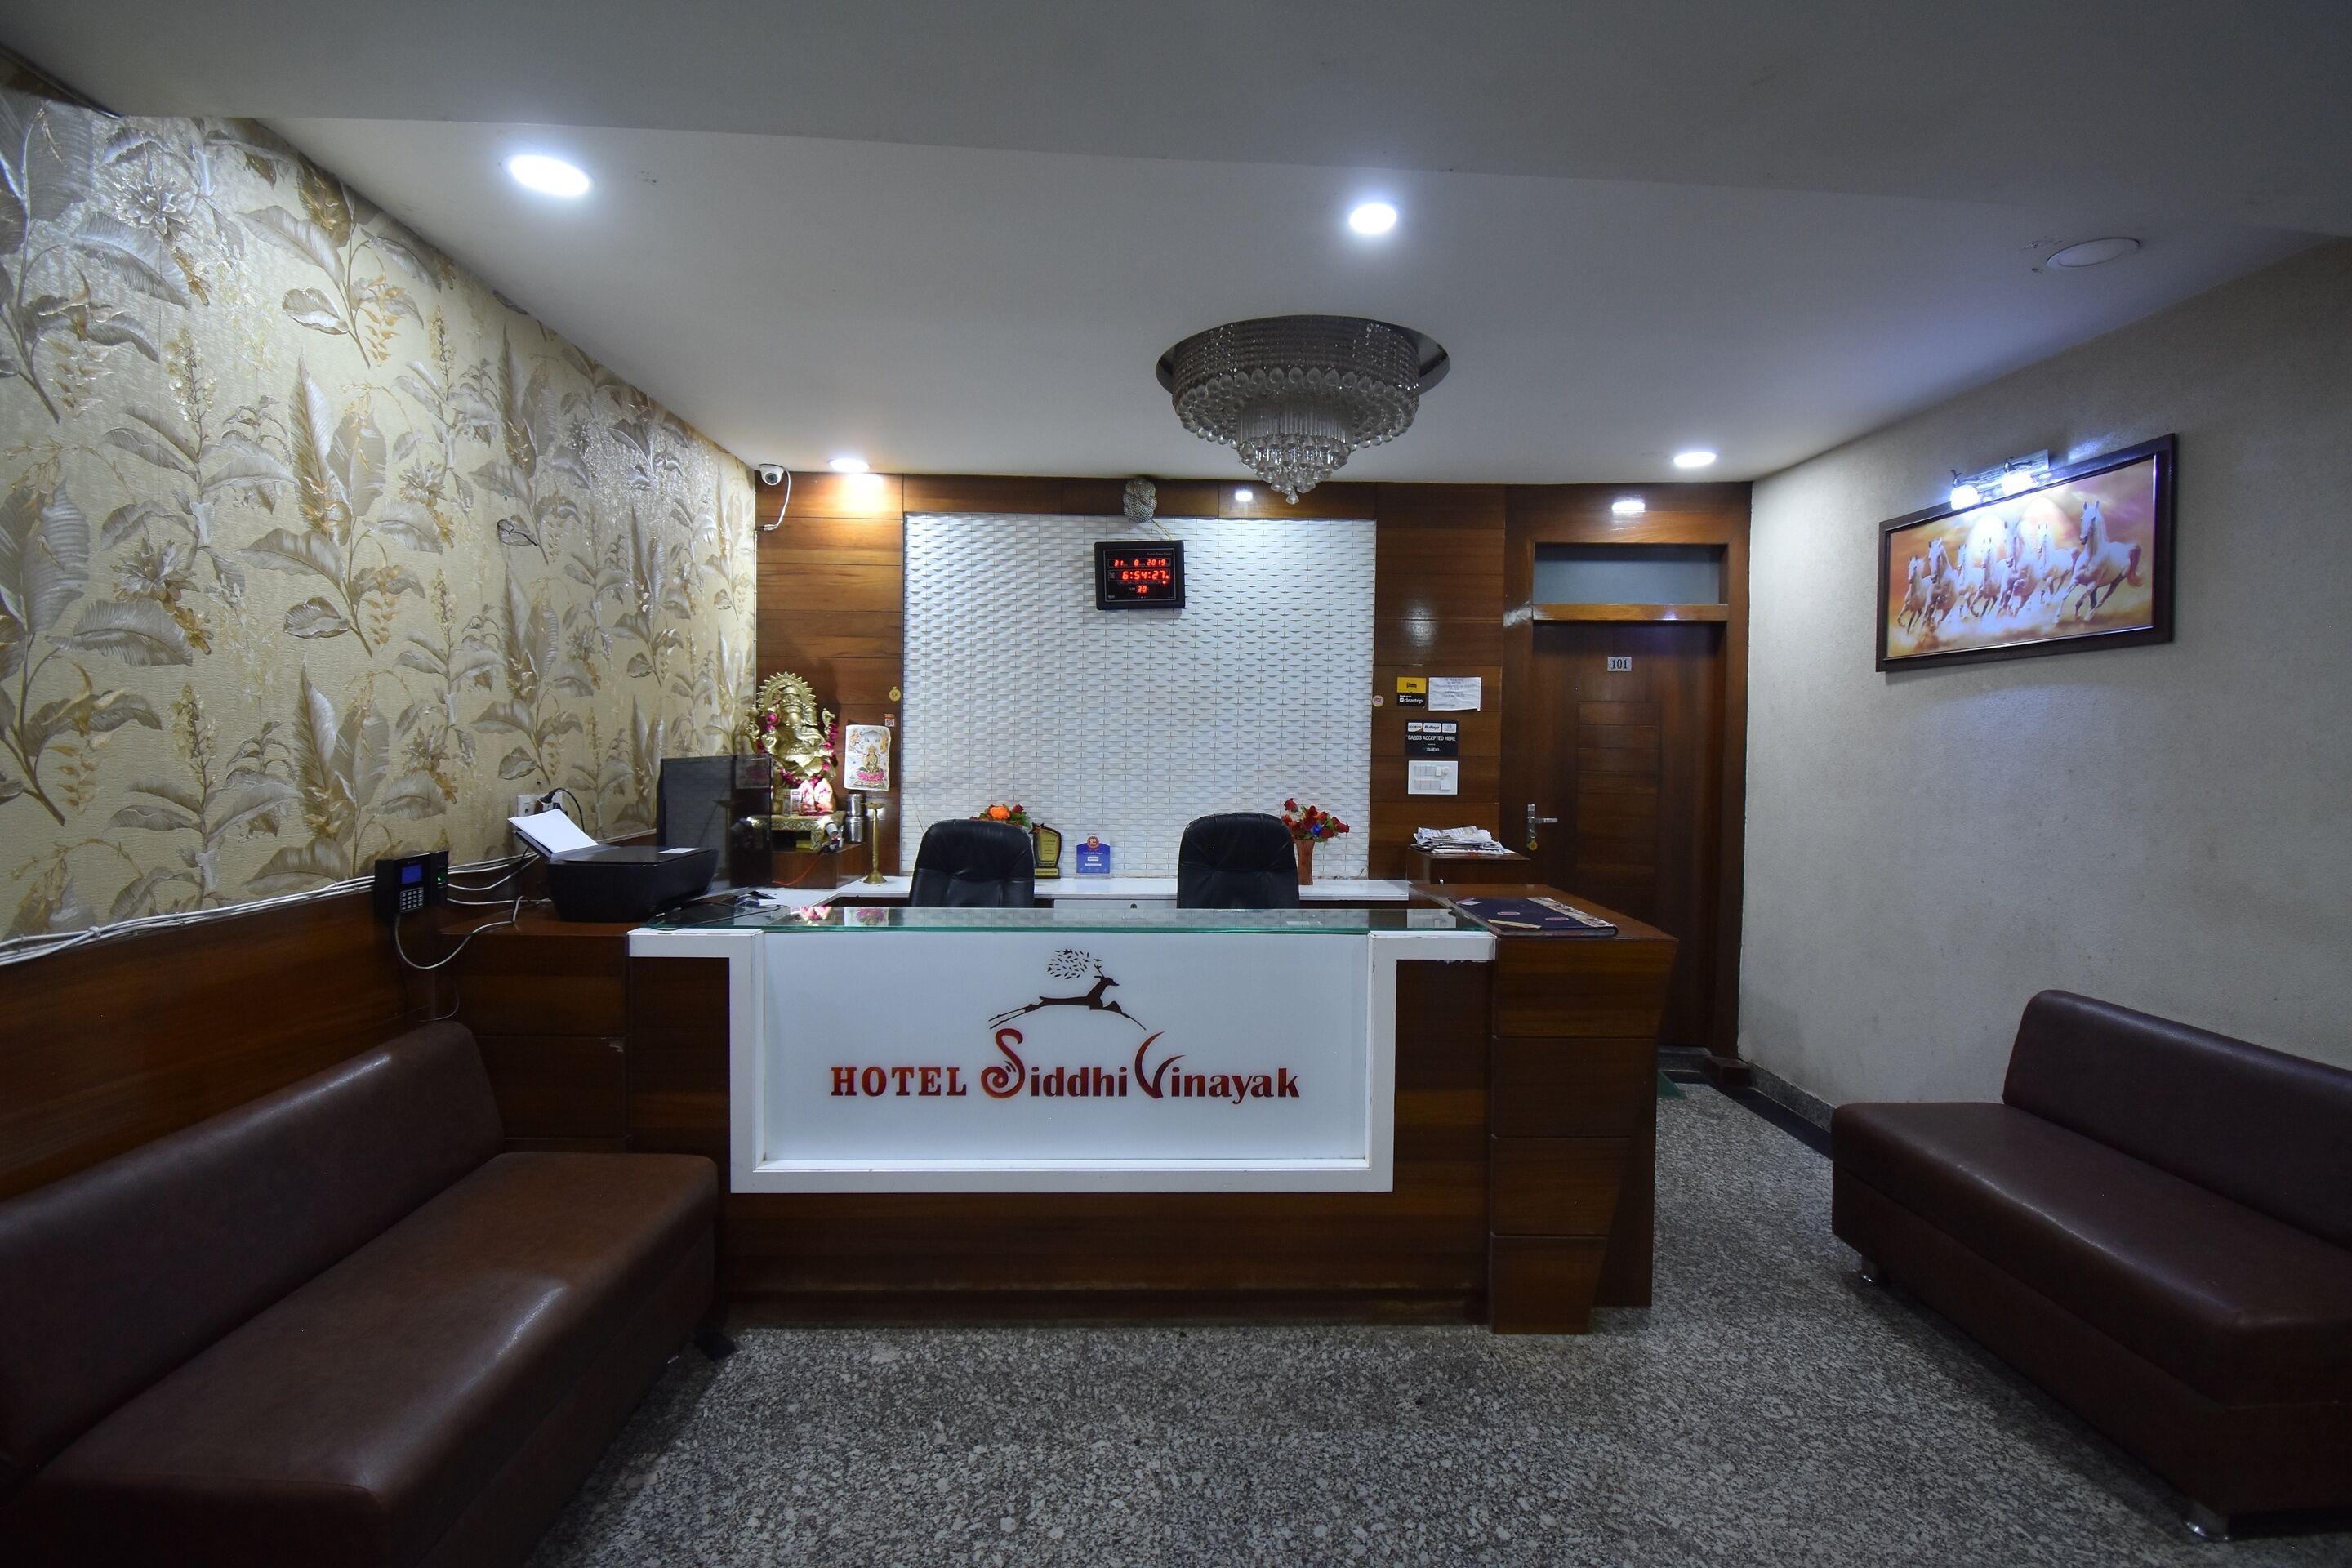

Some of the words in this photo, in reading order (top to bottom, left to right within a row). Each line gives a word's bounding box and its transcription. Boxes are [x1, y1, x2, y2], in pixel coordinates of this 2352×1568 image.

[1122, 570, 1166, 580] 6:54:27
[1612, 658, 1628, 669] 101
[831, 1067, 967, 1096] HOTEL
[981, 1028, 1127, 1099] Siddhi
[1134, 1031, 1300, 1104] Vinayak
